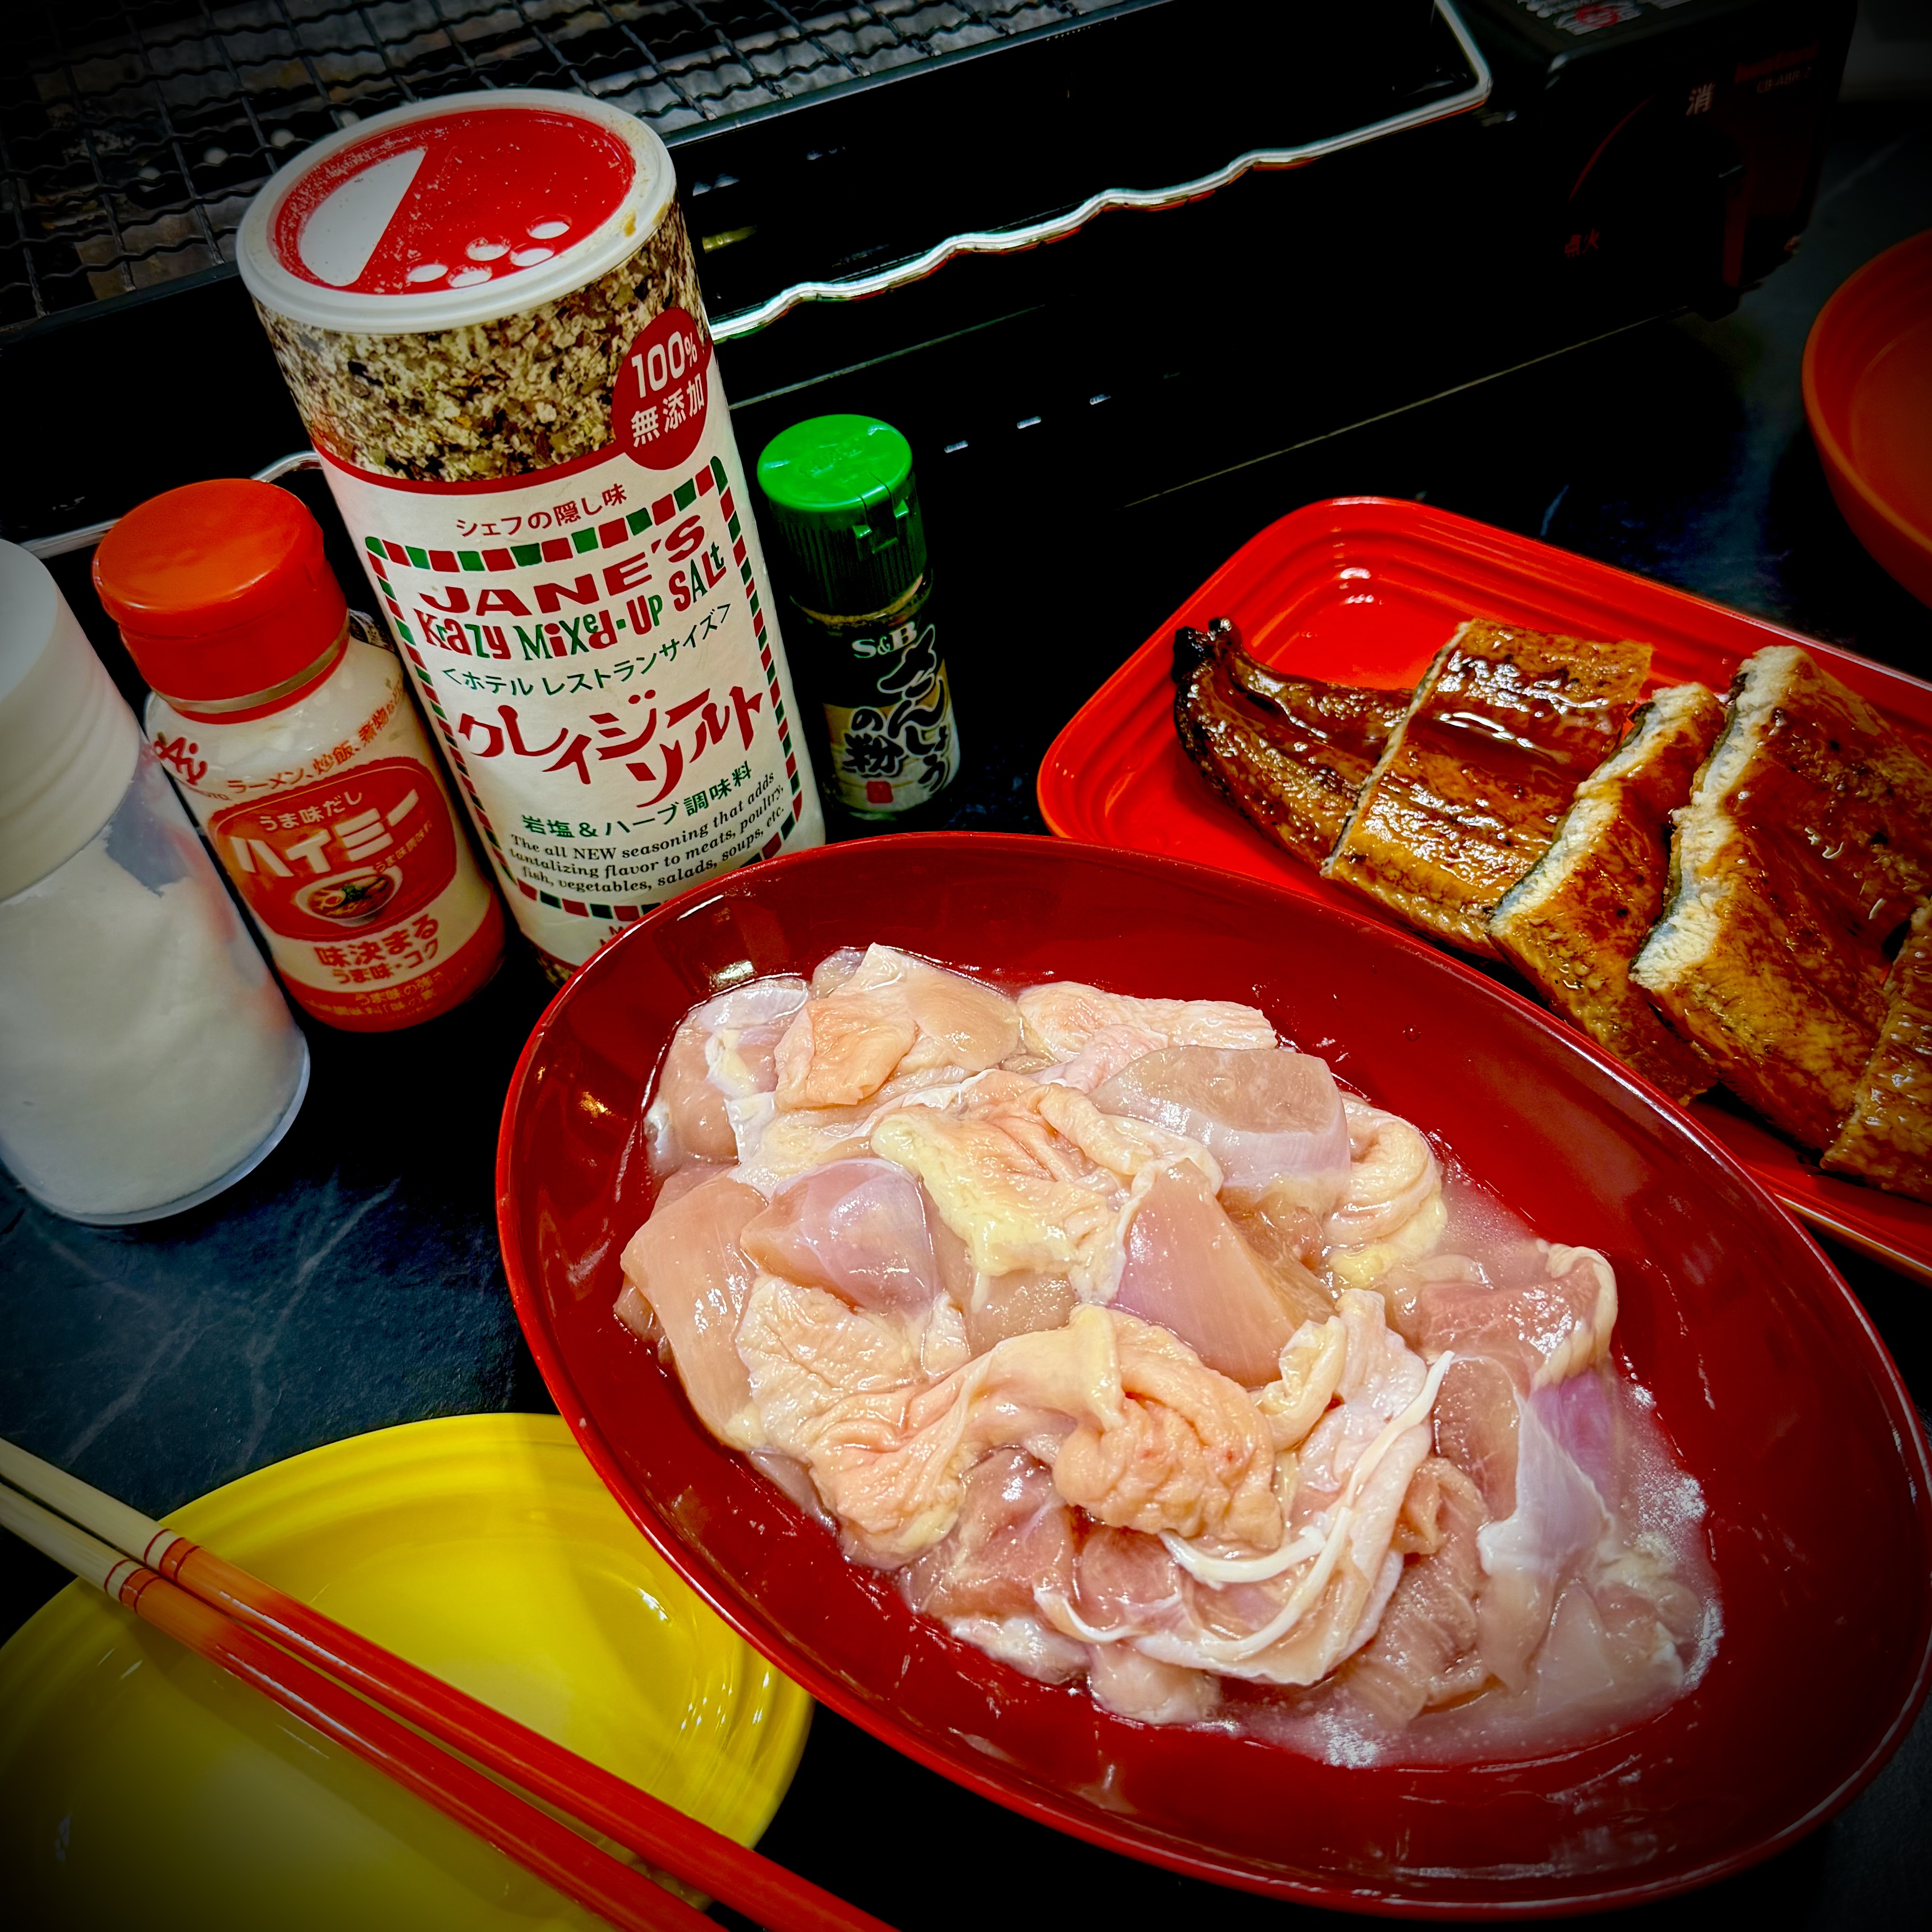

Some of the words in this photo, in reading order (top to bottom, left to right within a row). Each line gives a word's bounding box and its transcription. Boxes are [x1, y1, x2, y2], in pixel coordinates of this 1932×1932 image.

[1686, 80, 1716, 117] 消
[1564, 228, 1600, 259] 点火
[632, 331, 697, 398] 100%
[631, 373, 705, 447] 無添加
[457, 483, 627, 537] シェフの隠し味
[418, 515, 704, 616] JANE'S
[413, 609, 511, 659] Krazy
[851, 619, 919, 659] S&B
[842, 706, 908, 777] の粉
[876, 623, 951, 794] さんしょう
[230, 789, 418, 877] ハイミー
[259, 791, 362, 831] うま味だし
[509, 848, 599, 879] tantalizing
[604, 860, 659, 879] flavor
[664, 855, 680, 868] to
[686, 829, 737, 860] meats,
[739, 785, 784, 835] poultry,
[511, 834, 540, 852] The
[545, 846, 568, 857] all
[573, 848, 617, 860] NEW
[622, 823, 708, 858] seasoning
[713, 800, 744, 828] that
[748, 771, 775, 805] adds
[522, 866, 555, 887] fish,
[558, 880, 653, 893] vegetables,
[657, 858, 718, 887] salads,
[721, 828, 764, 862] soups,
[767, 806, 785, 828] etc.
[314, 913, 439, 967] 味決まる
[333, 938, 438, 984] うま味・コク
